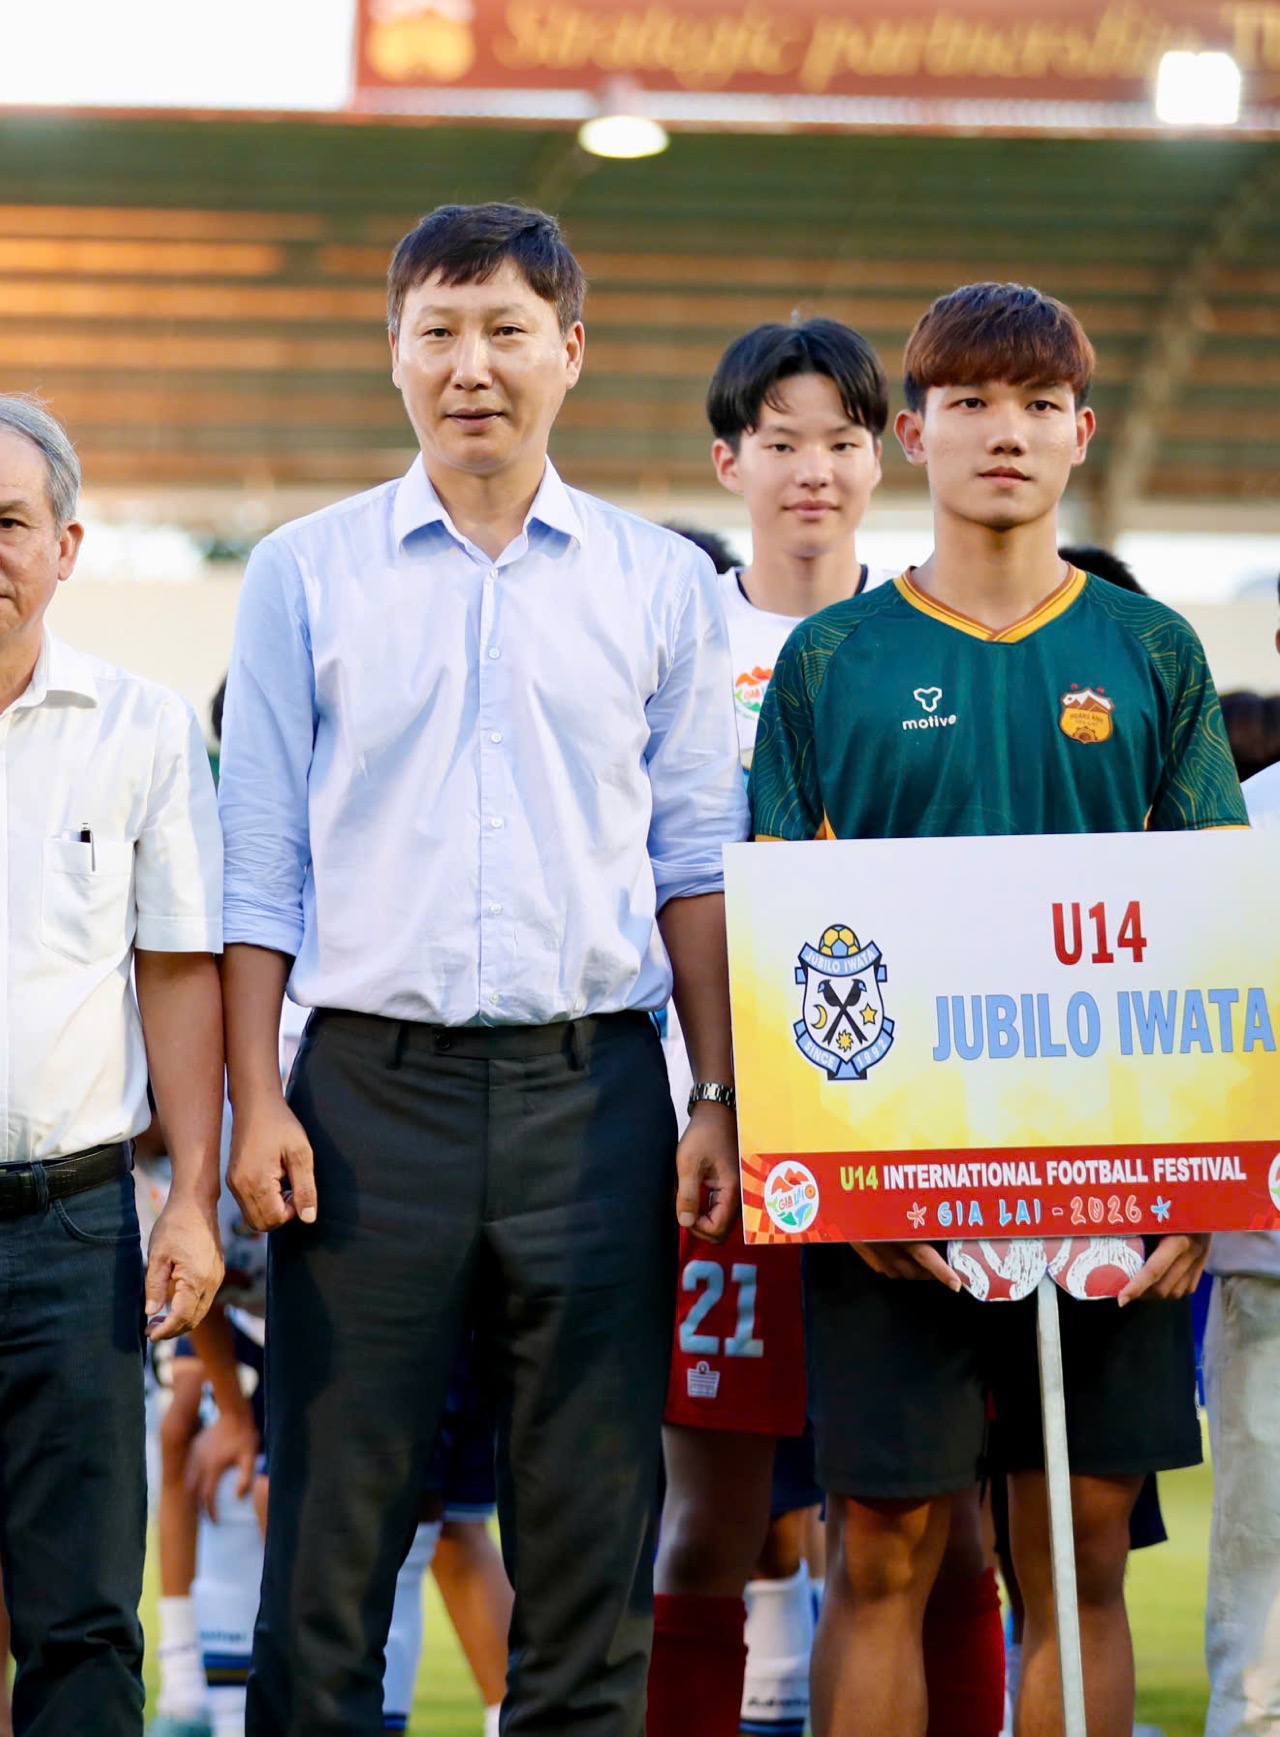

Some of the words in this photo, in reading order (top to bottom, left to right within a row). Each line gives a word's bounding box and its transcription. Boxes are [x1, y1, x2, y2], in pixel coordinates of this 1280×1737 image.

[902, 714, 957, 730] motive
[1051, 900, 1148, 966] U14
[805, 950, 841, 974] JUBILO
[843, 949, 877, 974] IWATA
[932, 990, 1101, 1061] JUBILO
[1116, 986, 1277, 1056] IWATA
[803, 1040, 837, 1069] SINCE
[856, 1038, 888, 1068] 1992
[839, 1165, 879, 1191] U14
[882, 1161, 1042, 1190] INTERNATIONAL
[1046, 1158, 1149, 1186] FOOTBALL
[1152, 1155, 1248, 1182] FESTIVAL
[937, 1200, 984, 1227] GIA
[998, 1198, 1042, 1227] LAI
[1070, 1195, 1143, 1226] 2026
[678, 1260, 765, 1358] 21
